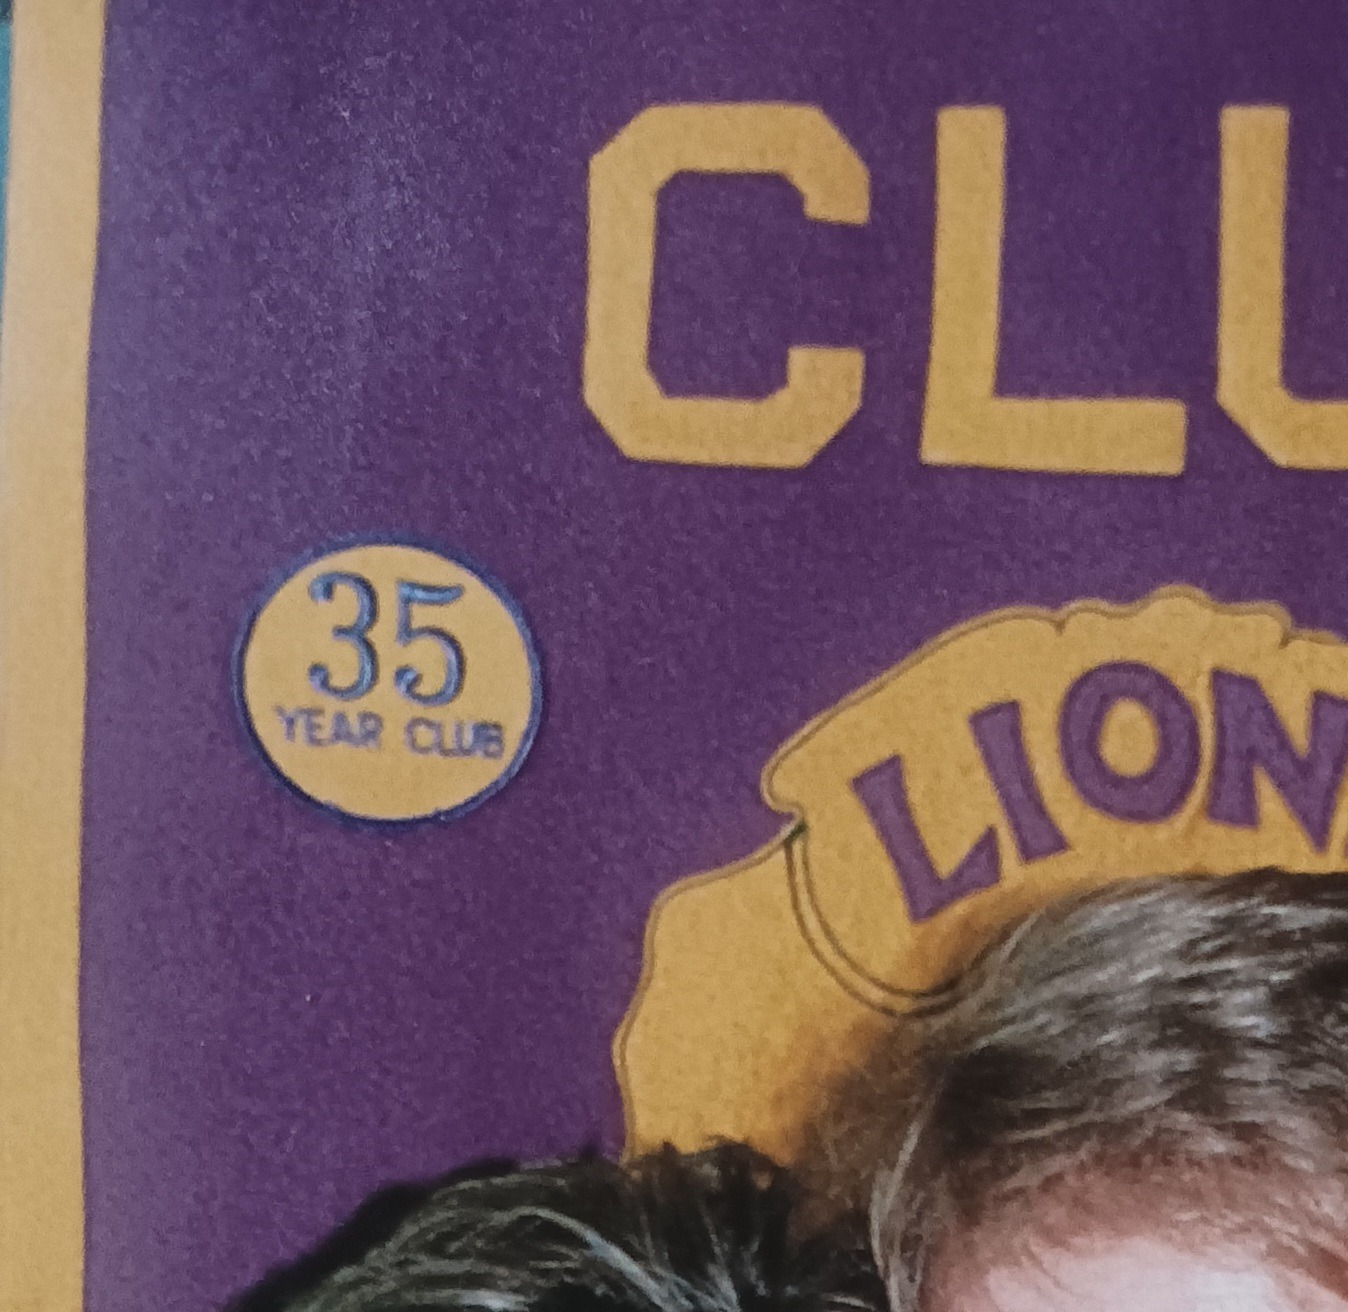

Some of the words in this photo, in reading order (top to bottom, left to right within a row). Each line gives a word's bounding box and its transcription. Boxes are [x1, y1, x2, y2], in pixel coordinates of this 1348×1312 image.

[307, 569, 467, 708] 35
[273, 704, 383, 748] YEAR
[403, 716, 505, 760] CLUB
